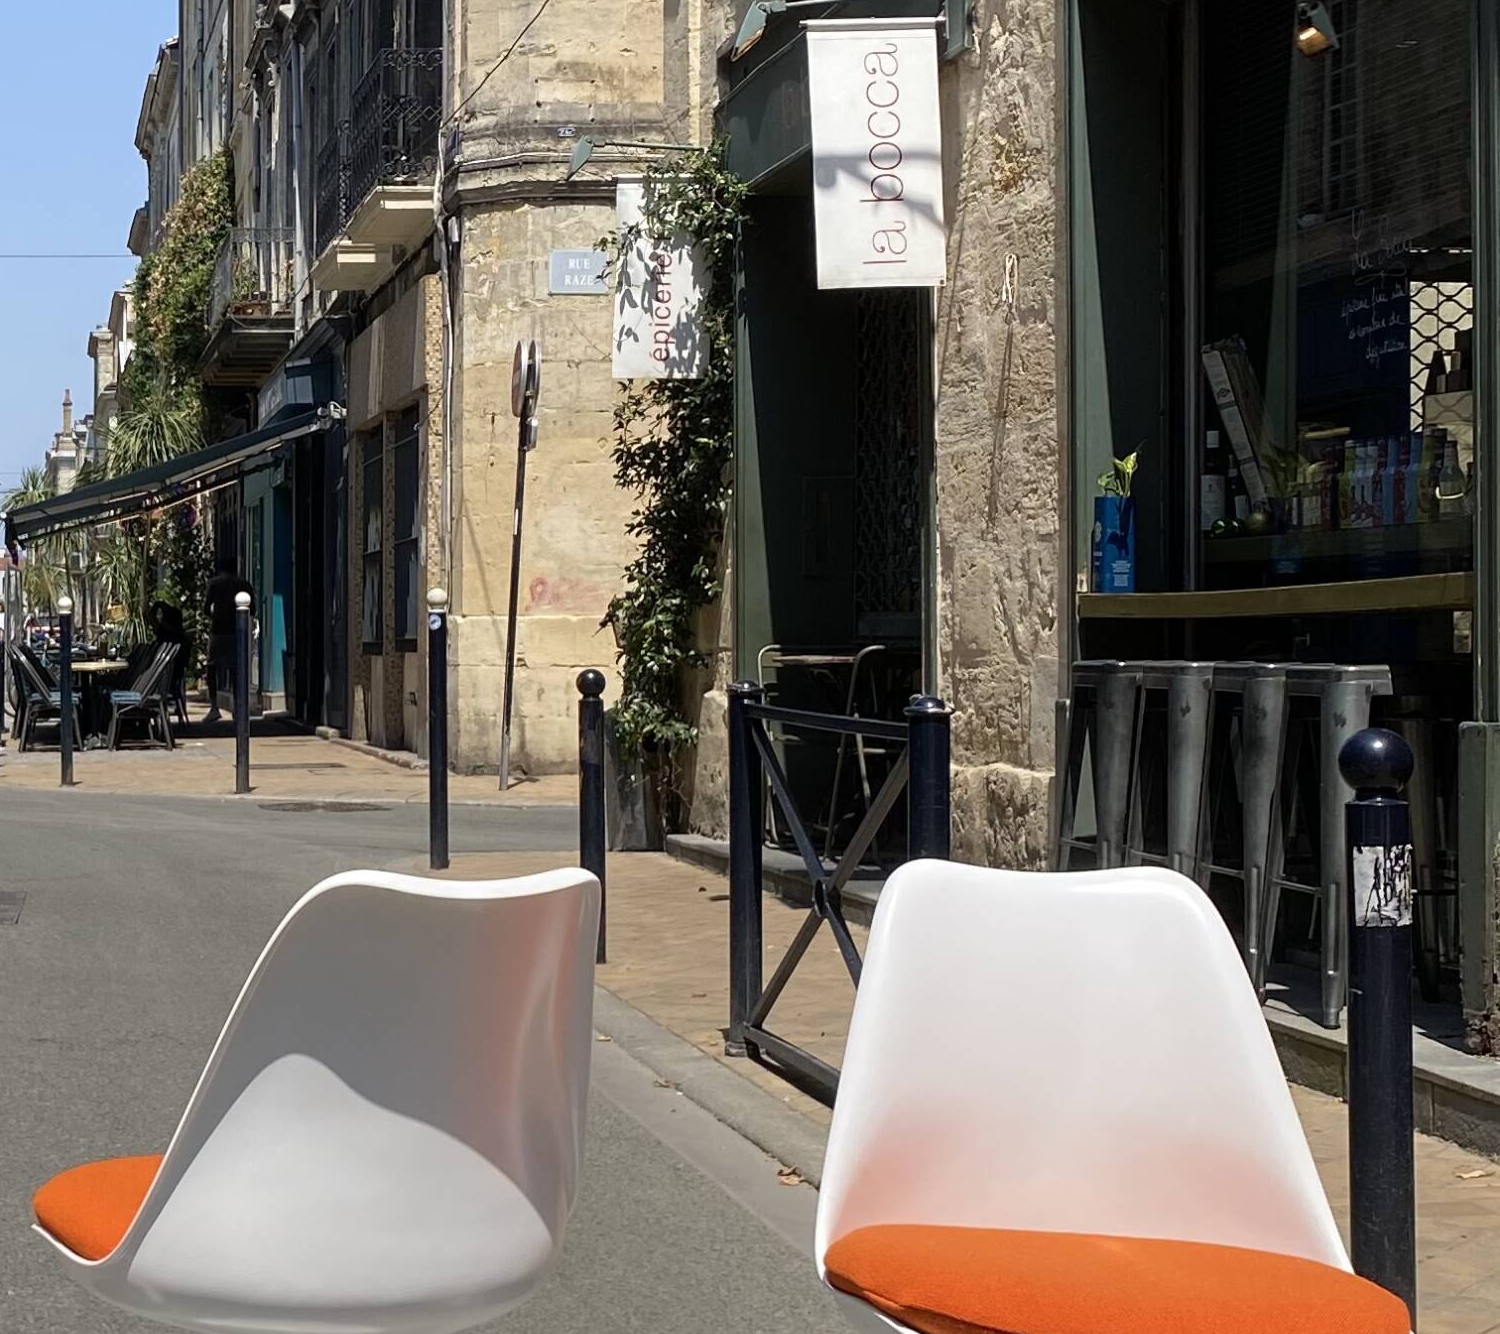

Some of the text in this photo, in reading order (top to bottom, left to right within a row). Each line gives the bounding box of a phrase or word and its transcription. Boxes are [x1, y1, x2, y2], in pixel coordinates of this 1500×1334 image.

[859, 42, 908, 265] la bocca
[568, 258, 591, 269] RUE
[564, 274, 595, 286] RAZE
